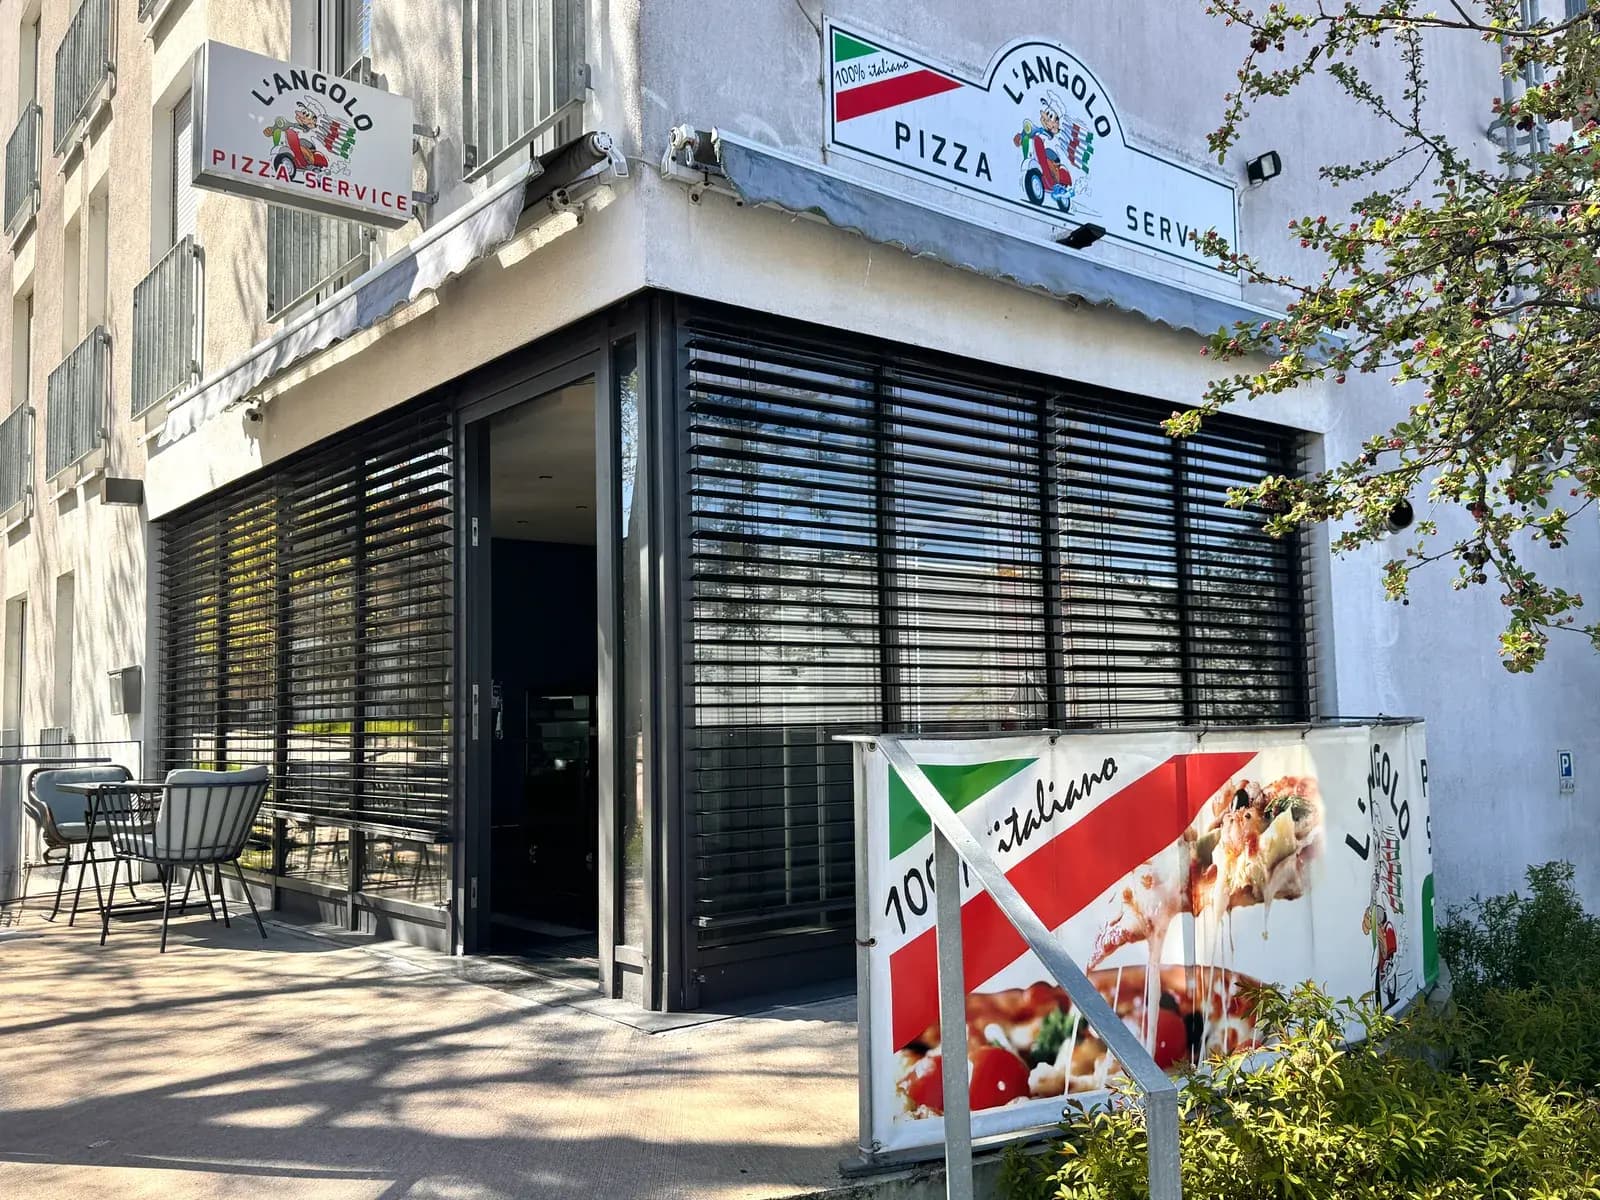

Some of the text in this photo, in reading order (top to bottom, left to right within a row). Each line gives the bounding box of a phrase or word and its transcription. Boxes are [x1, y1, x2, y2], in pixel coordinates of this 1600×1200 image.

[251, 69, 374, 132] L'ANGOLO
[835, 58, 909, 88] 100% italiano
[1003, 55, 1111, 138] L'ANGOLO
[212, 149, 408, 211] PIZZA SERVICE
[895, 120, 1218, 255] PIZZA SERVI
[1562, 755, 1570, 775] P
[1345, 743, 1410, 861] L'NGOLO
[885, 757, 1119, 935] 10 italiano
